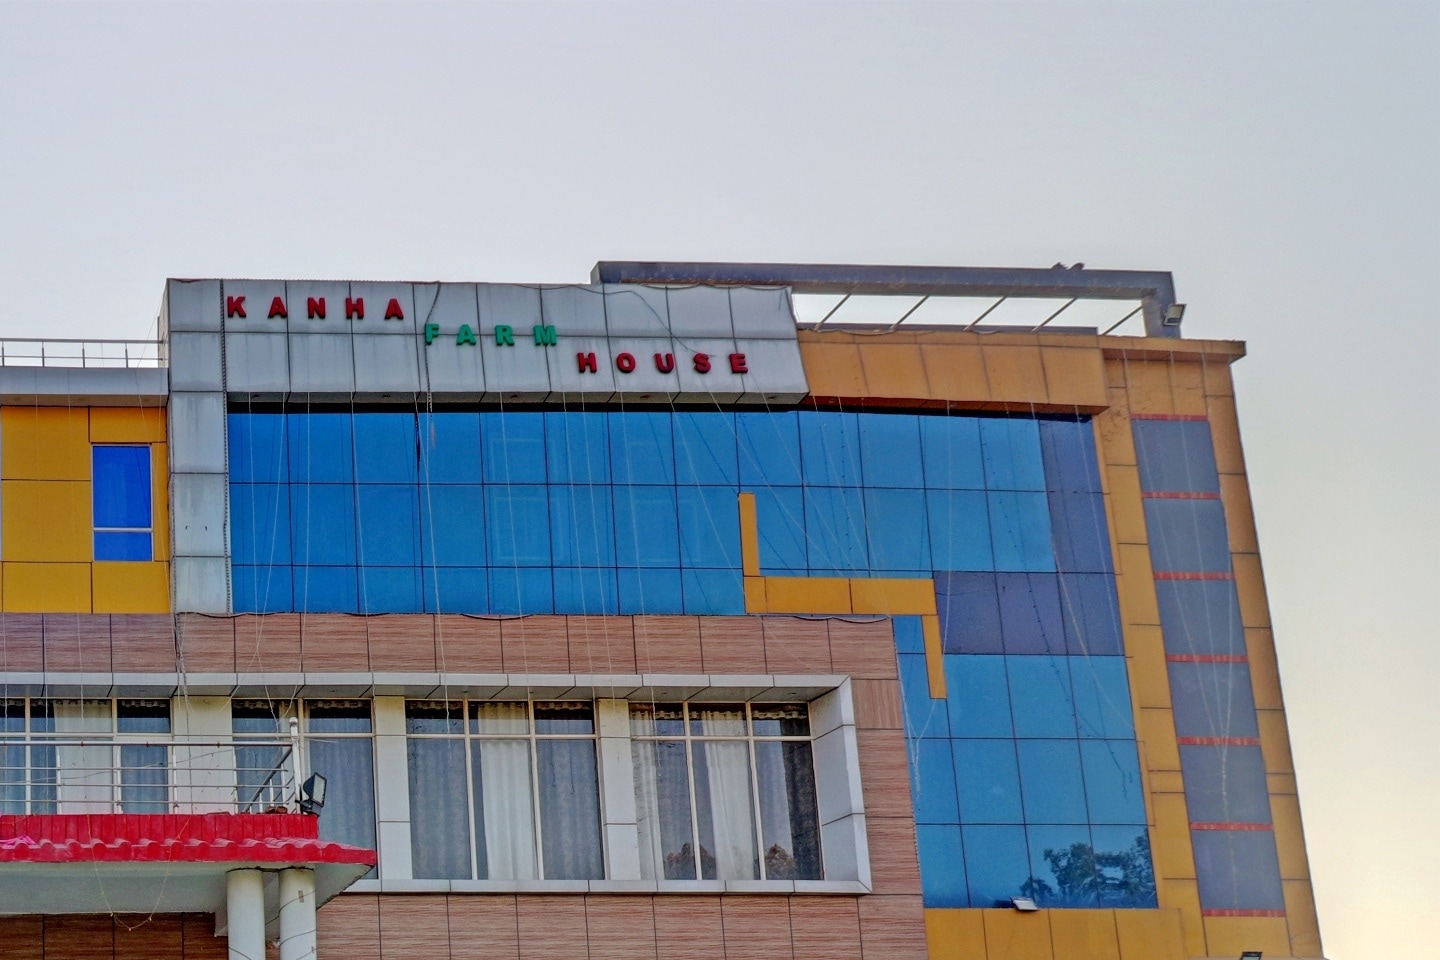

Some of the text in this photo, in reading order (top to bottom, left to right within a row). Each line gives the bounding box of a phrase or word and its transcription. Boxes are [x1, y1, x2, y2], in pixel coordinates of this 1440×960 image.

[227, 296, 404, 320] KANHA
[424, 323, 558, 346] FARM
[577, 352, 748, 373] HOUSE
